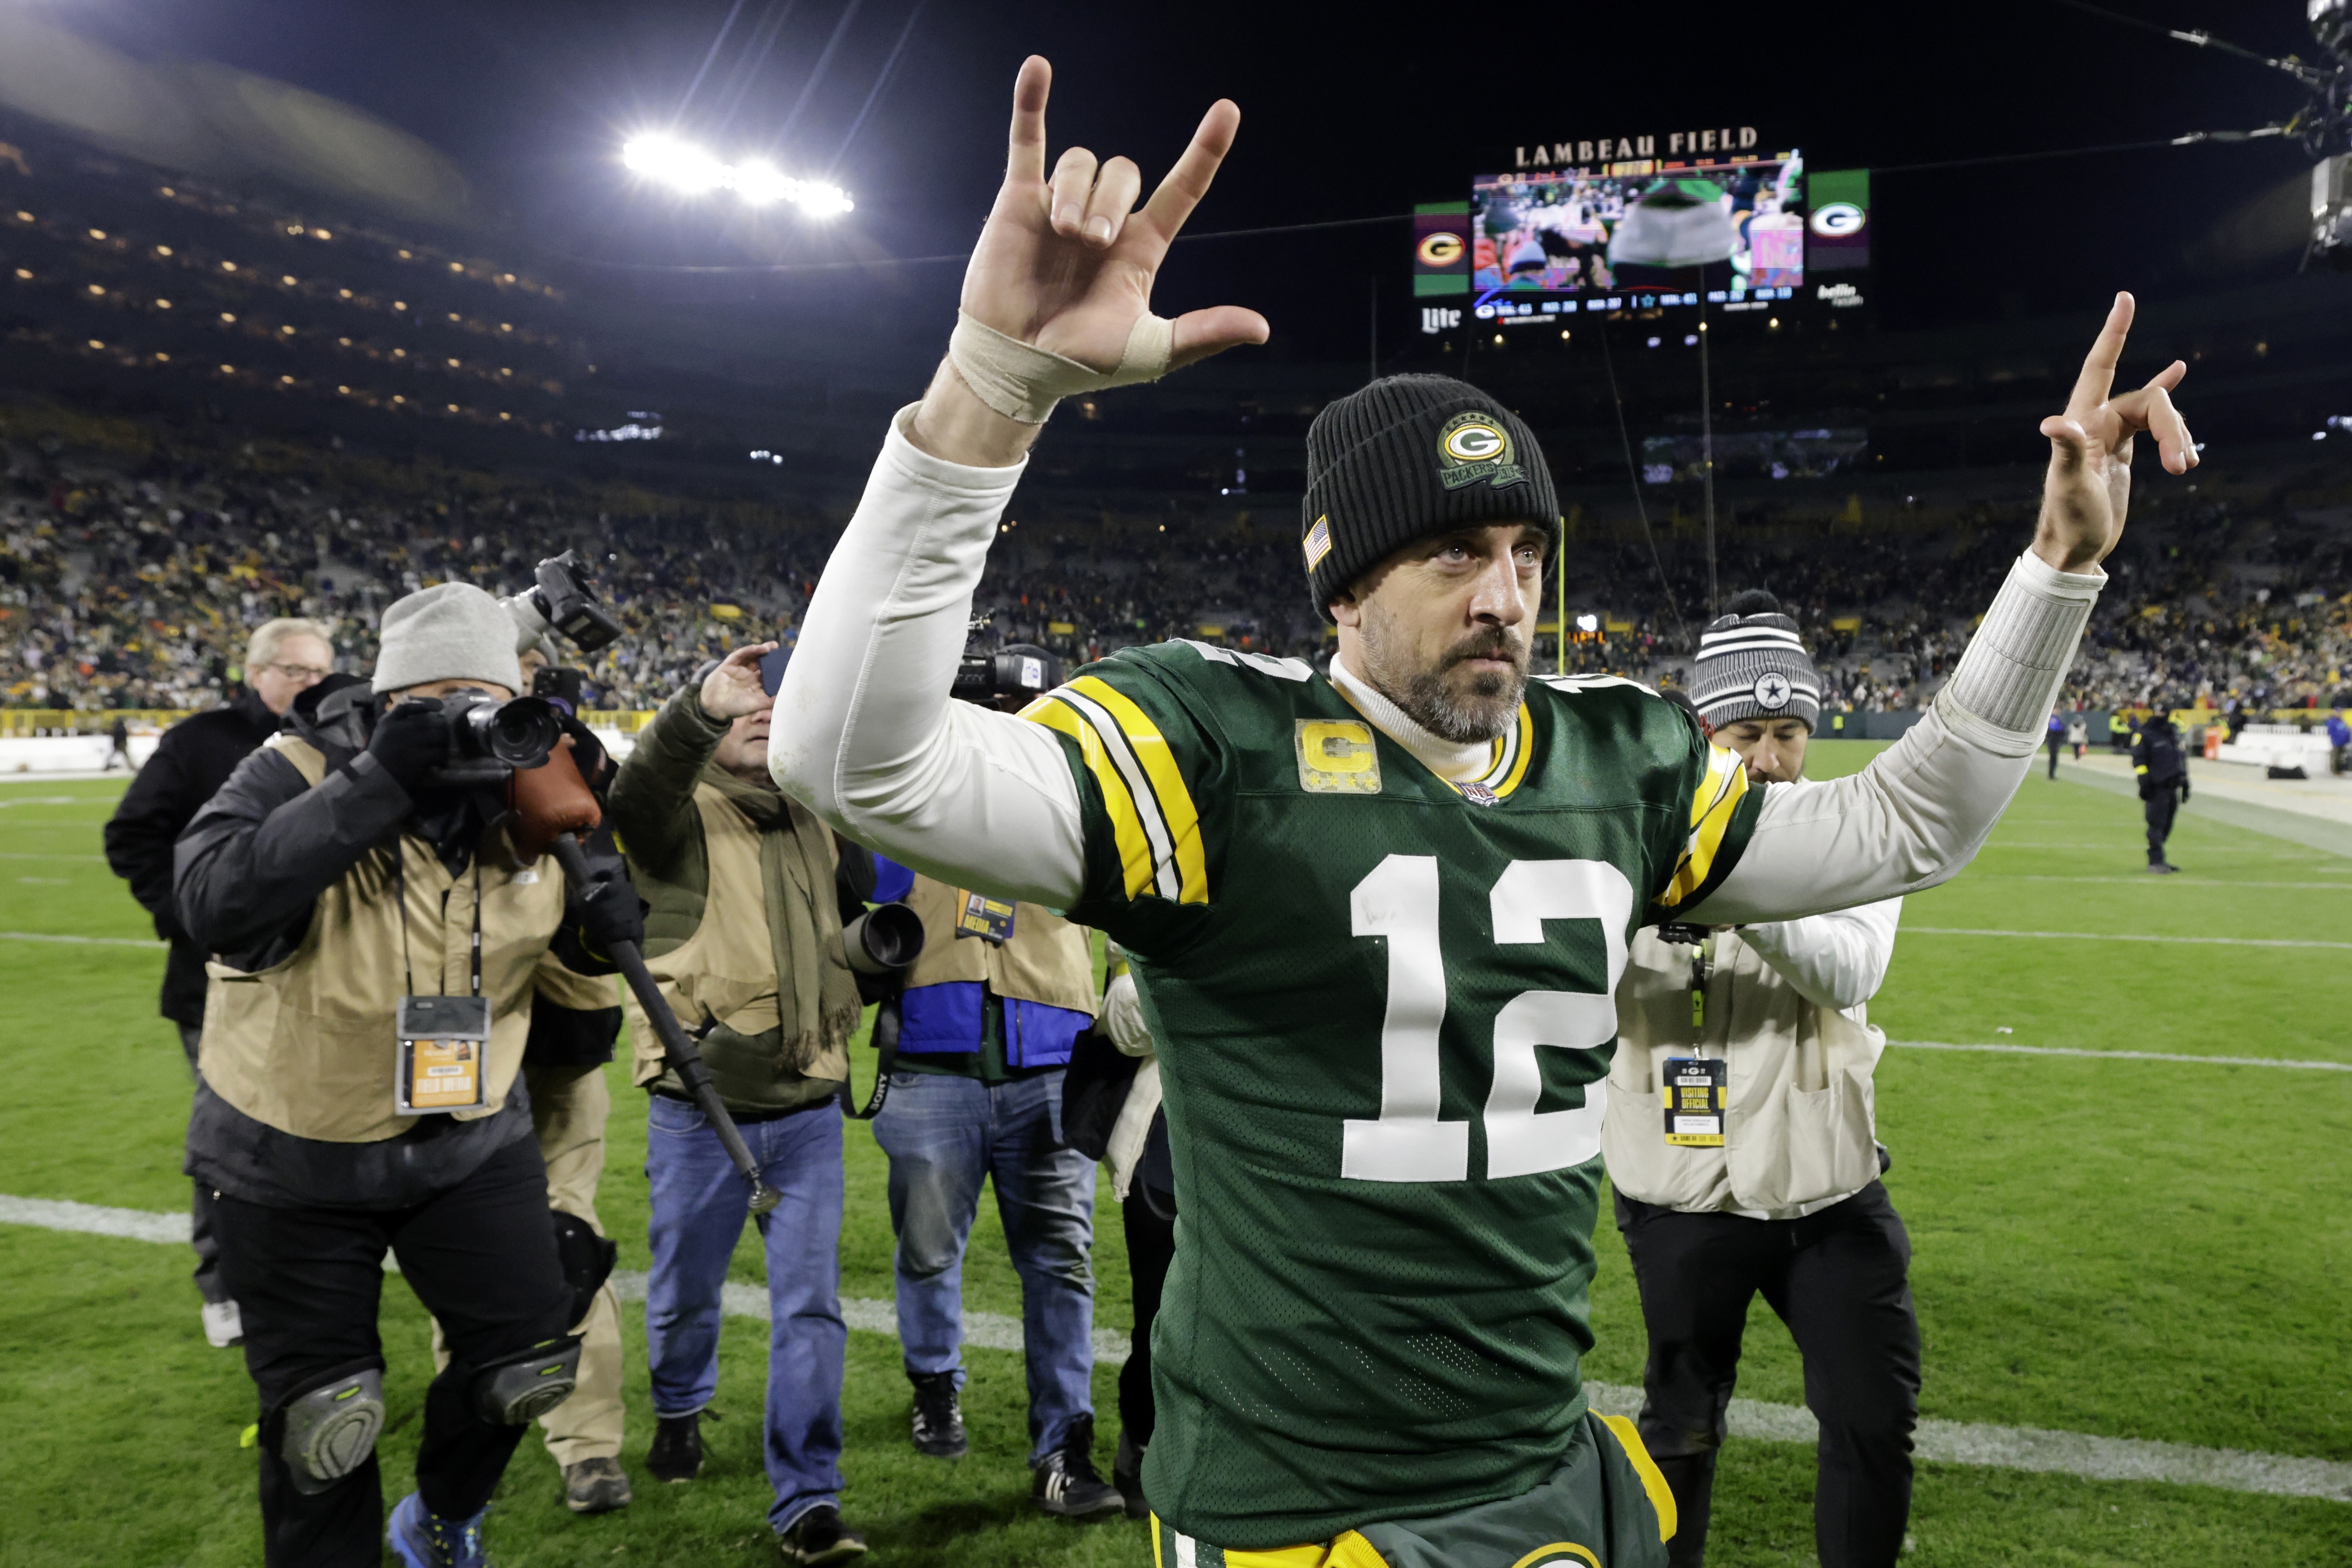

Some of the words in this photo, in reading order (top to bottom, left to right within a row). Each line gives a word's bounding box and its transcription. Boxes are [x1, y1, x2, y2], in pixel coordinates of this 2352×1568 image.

[1516, 135, 1654, 168] LAMBEAU
[1669, 127, 1757, 154] FIELD
[1422, 307, 1461, 334] Lite
[1443, 463, 1493, 485] PACKERS
[1500, 467, 1516, 479] 1919
[1761, 674, 1784, 683] COWBOYS
[1302, 724, 1373, 773] C
[1464, 786, 1493, 799] NFL
[963, 914, 990, 935] MEDIA
[1341, 854, 1633, 1182] 12
[1681, 1087, 1709, 1098] VISITING
[1682, 1098, 1709, 1109] OFFICIAL
